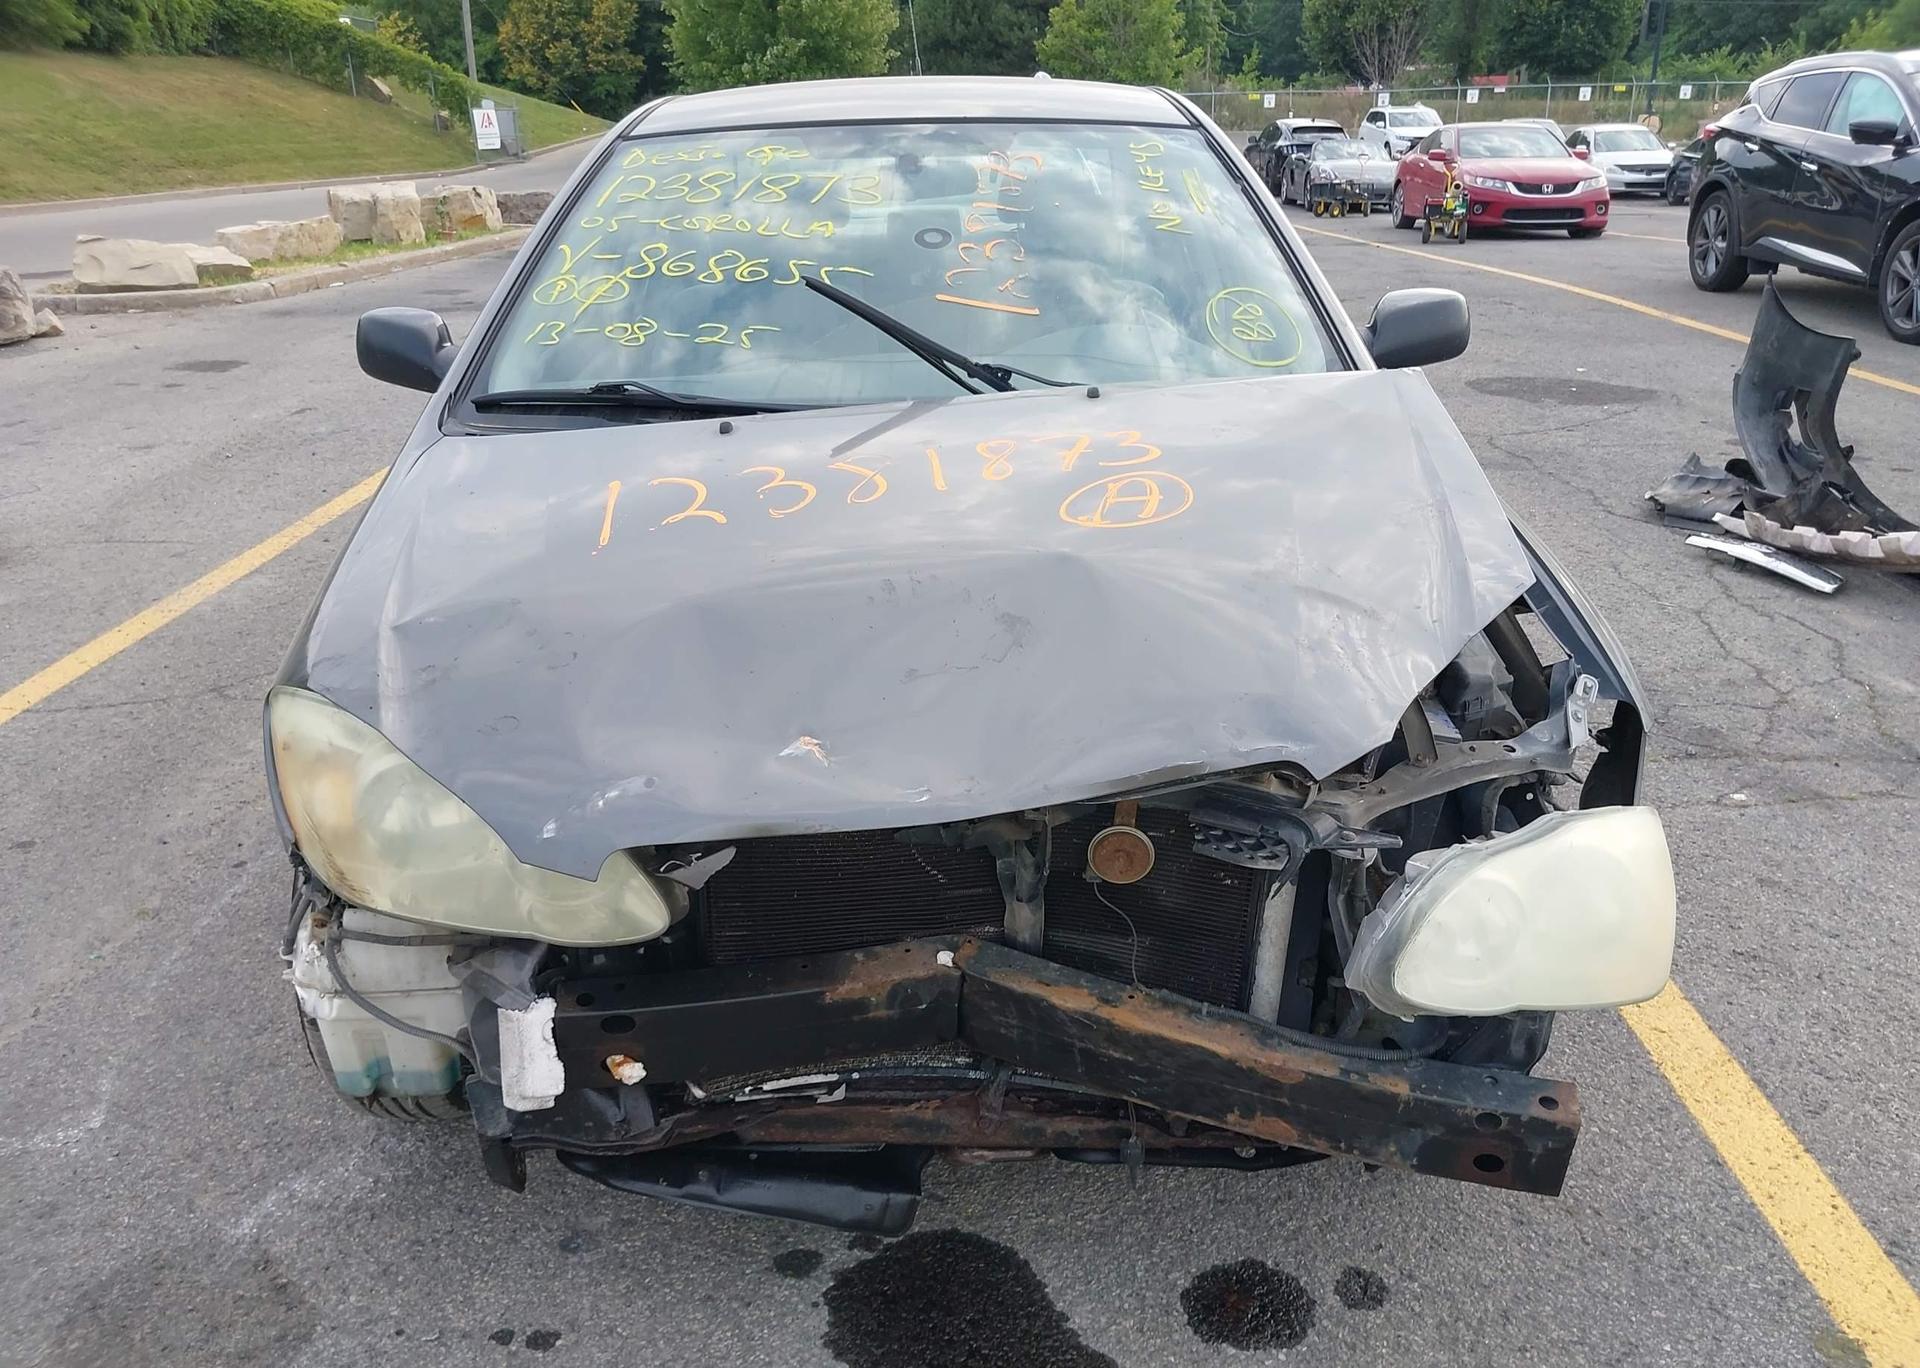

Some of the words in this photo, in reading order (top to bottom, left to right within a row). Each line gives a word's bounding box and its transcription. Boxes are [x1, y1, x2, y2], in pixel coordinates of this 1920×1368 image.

[1129, 142, 1169, 193] KEYS
[597, 170, 882, 207] 12381873
[1148, 200, 1192, 235] NO
[524, 317, 782, 350] 13-08-25
[597, 430, 1163, 547] 12381873
